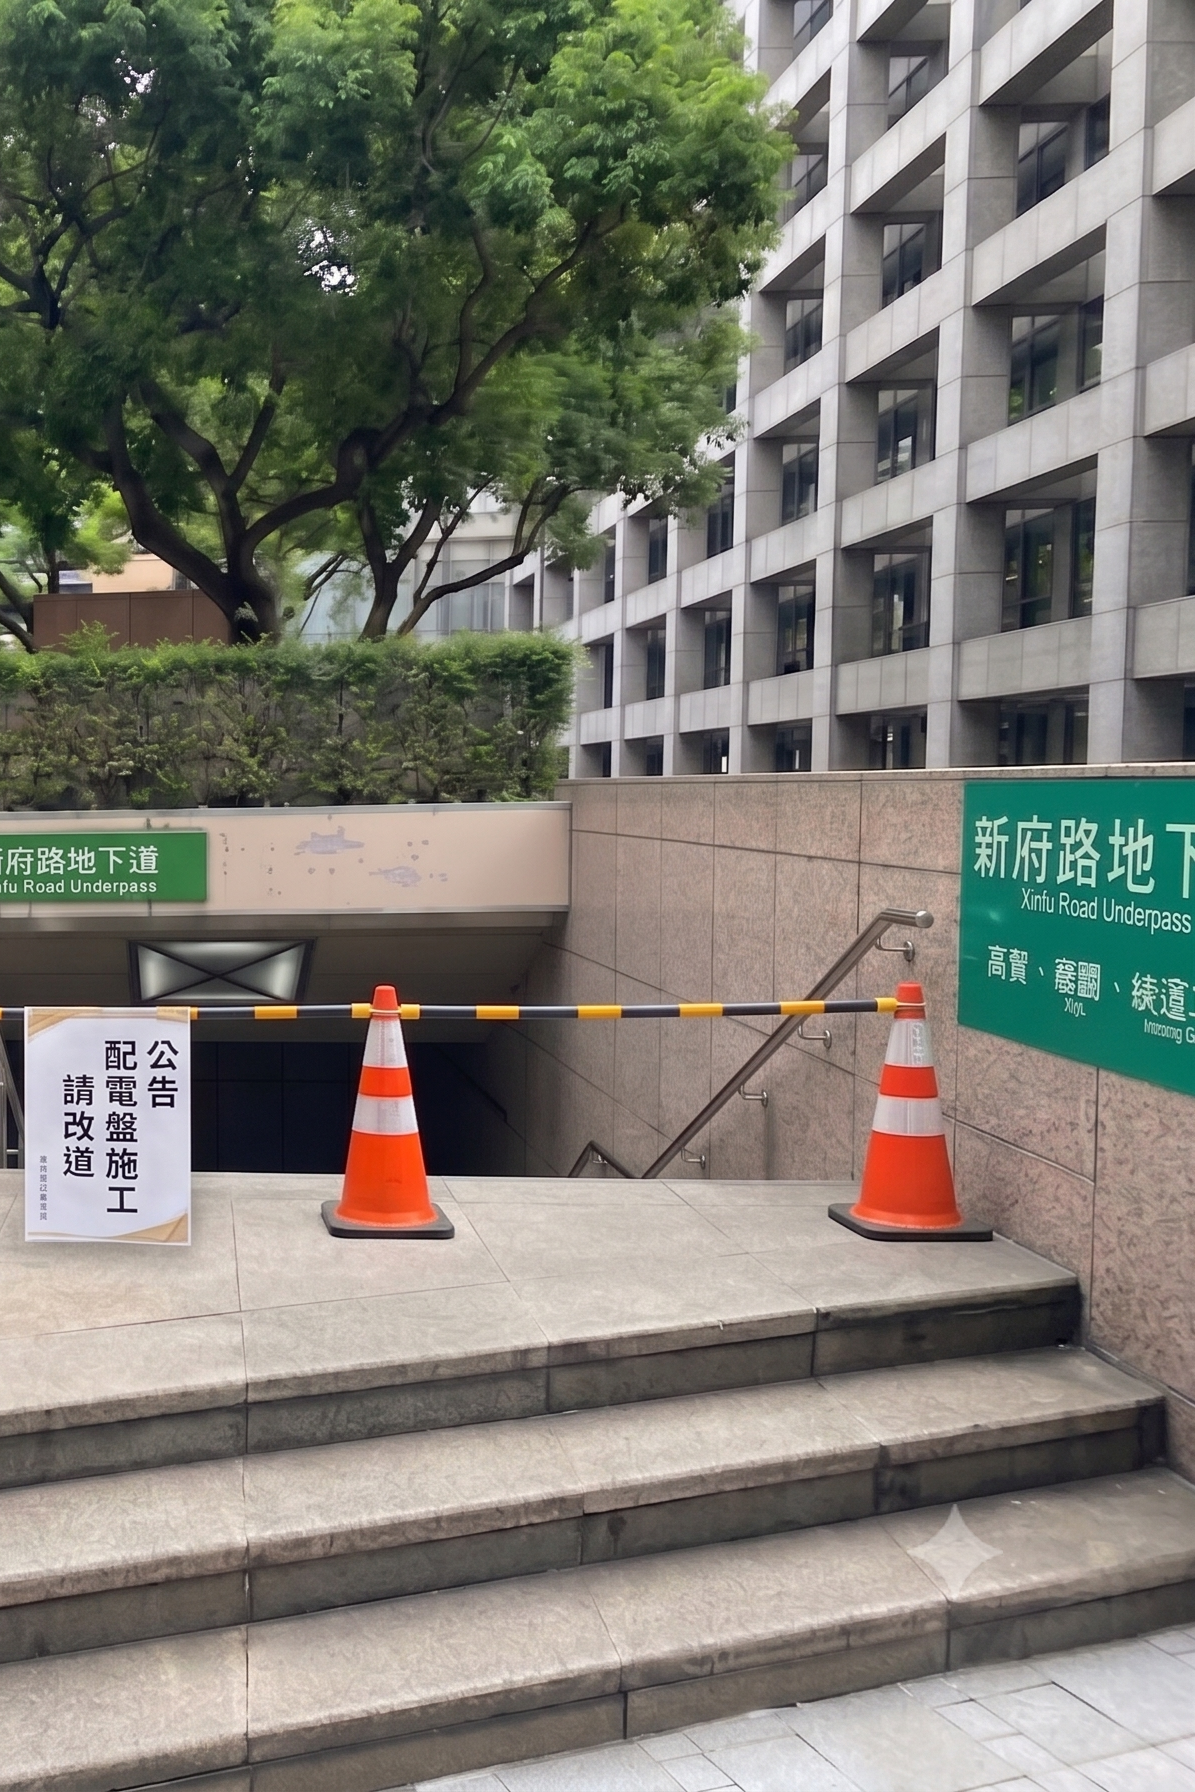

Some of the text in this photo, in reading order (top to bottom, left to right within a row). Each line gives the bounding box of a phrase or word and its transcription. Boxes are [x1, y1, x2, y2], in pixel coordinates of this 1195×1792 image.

[23, 879, 65, 894] Road
[70, 879, 157, 896] Underpass
[1021, 887, 1192, 935] Xinfu Road Underpass
[146, 1040, 179, 1109] 公告
[62, 1074, 95, 1178] 請改道
[104, 1040, 139, 1214] 配電盤施工
